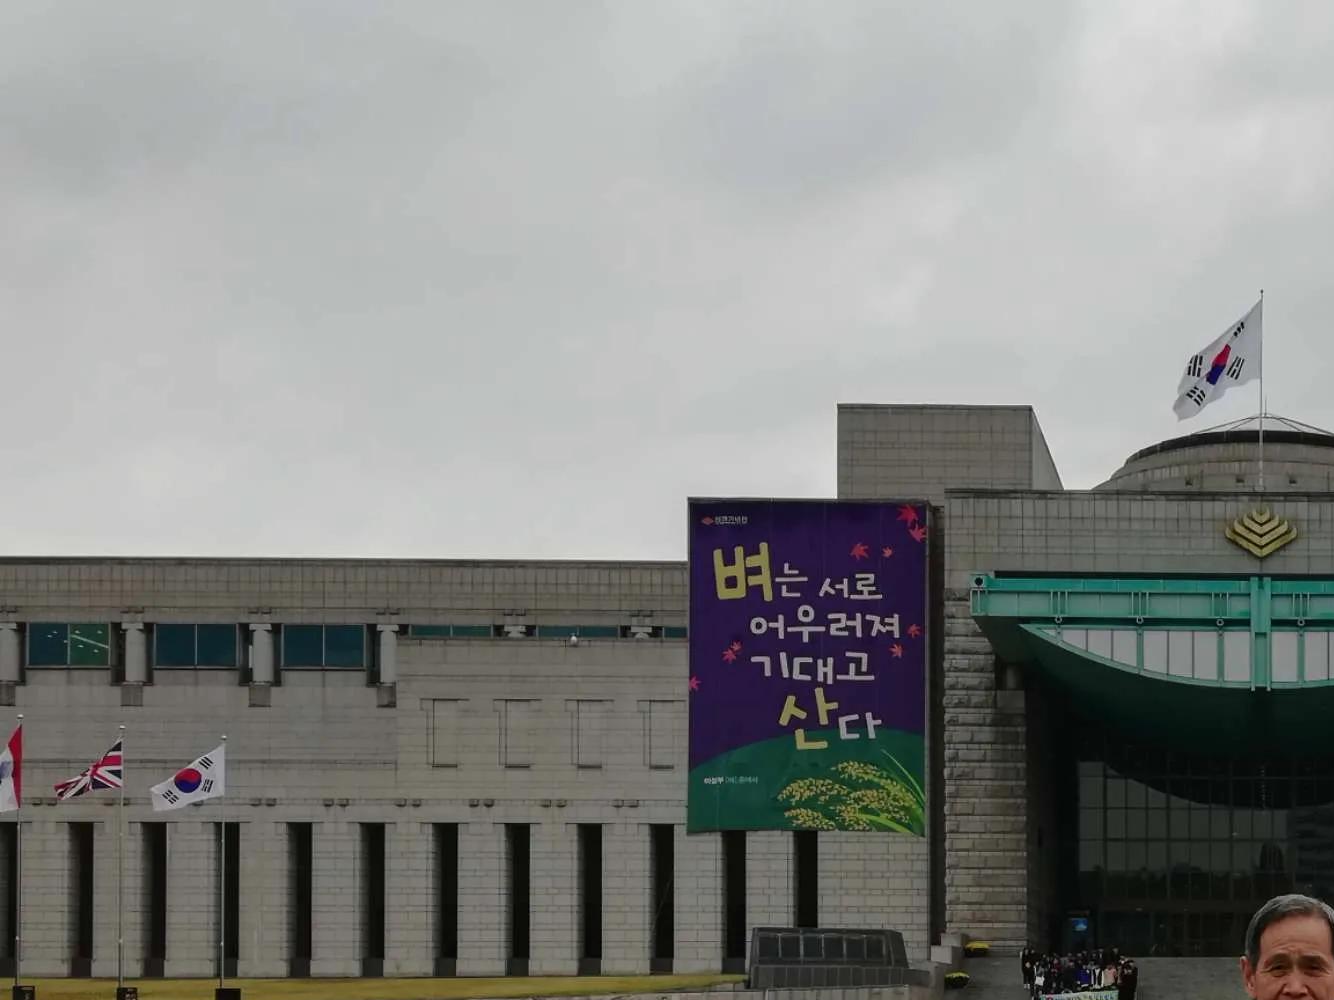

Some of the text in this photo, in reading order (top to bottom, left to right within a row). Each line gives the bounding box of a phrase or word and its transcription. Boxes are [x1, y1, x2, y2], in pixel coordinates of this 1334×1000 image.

[712, 541, 883, 602] 벼는 서로
[750, 604, 901, 643] 어우러져
[750, 652, 875, 685] 기대고
[778, 687, 883, 750] 산다
